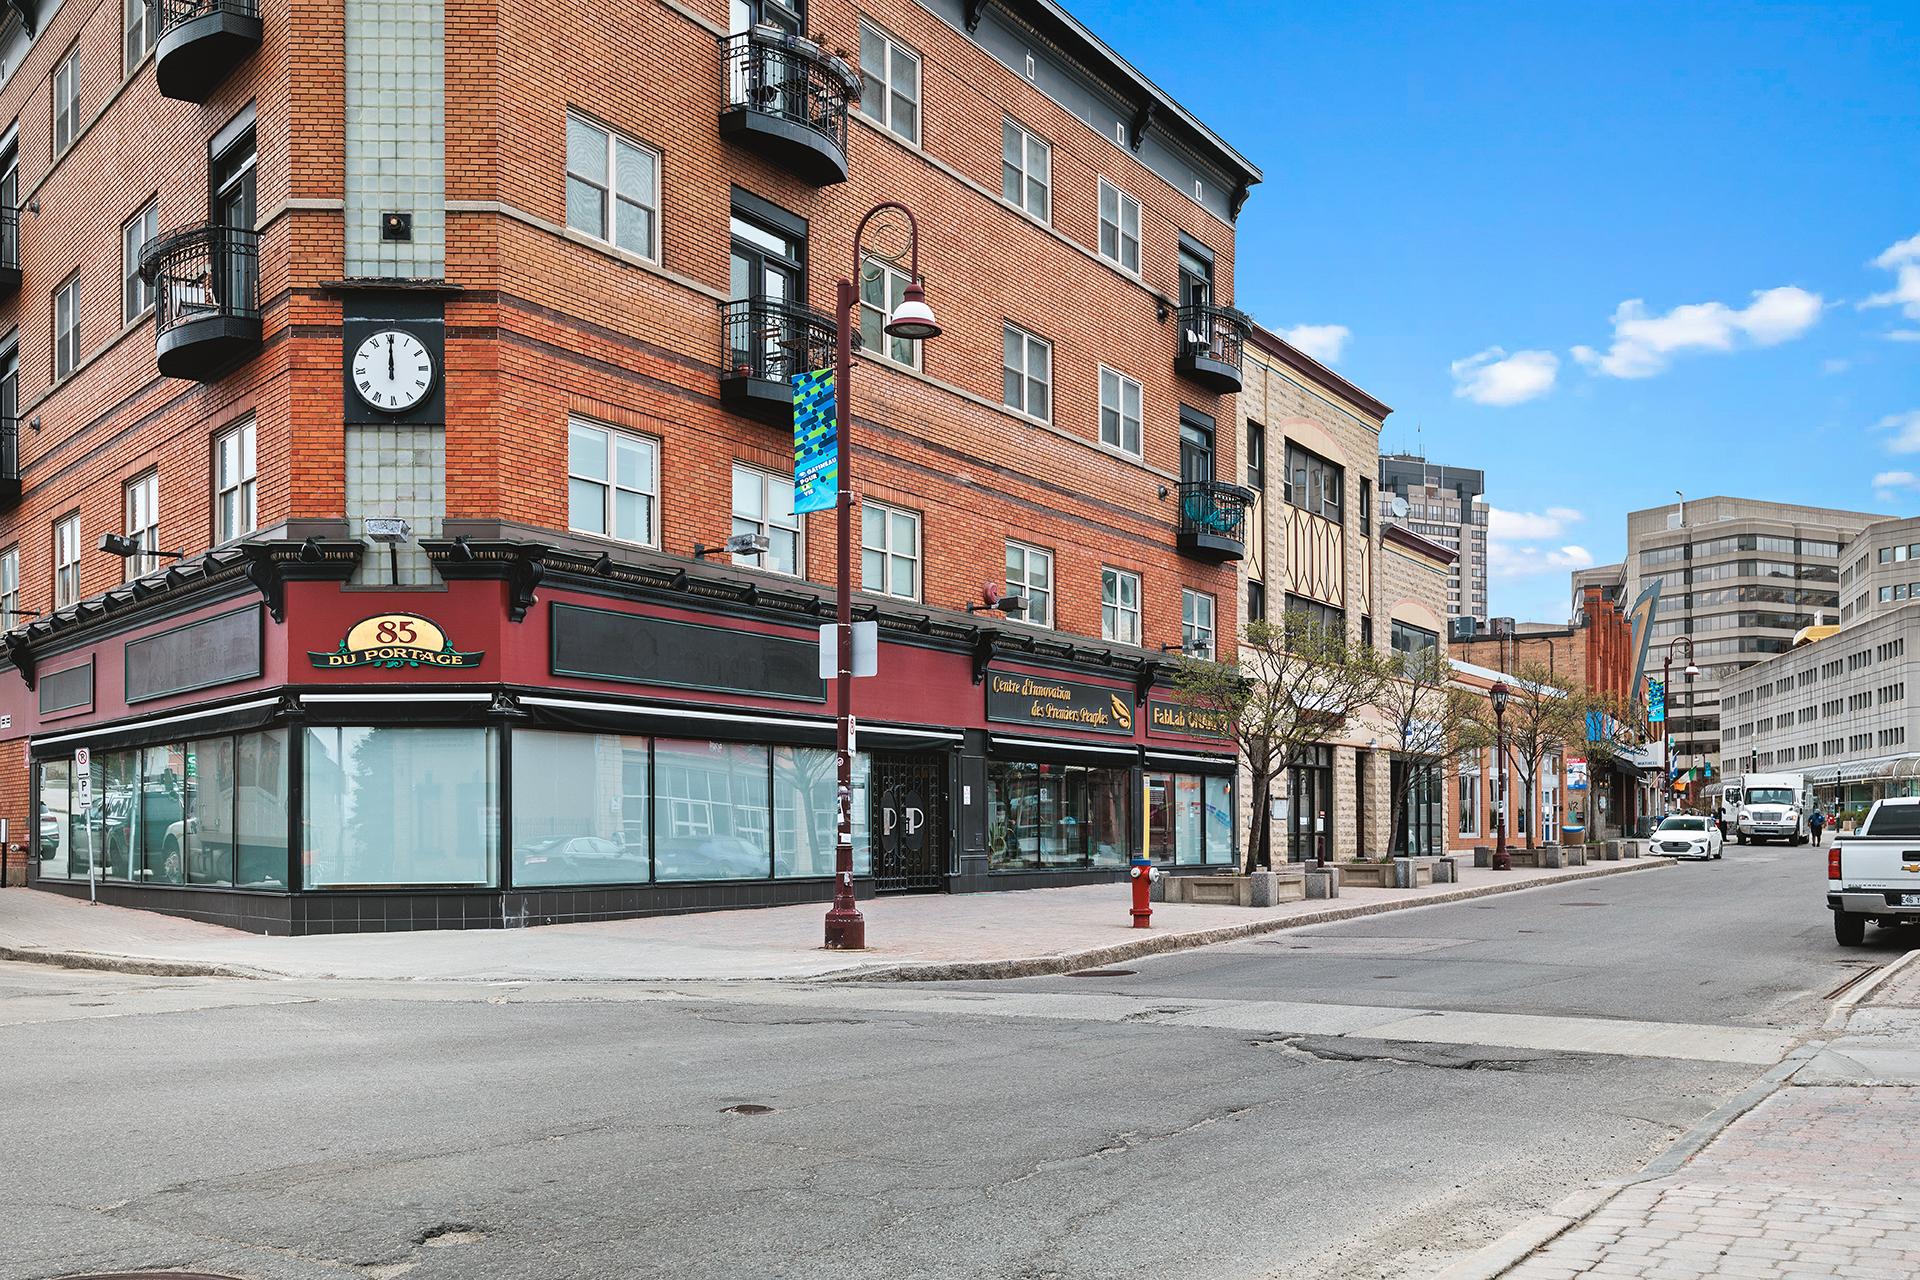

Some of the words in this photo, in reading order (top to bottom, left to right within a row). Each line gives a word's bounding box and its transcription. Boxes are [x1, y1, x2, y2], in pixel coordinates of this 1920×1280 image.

[358, 350, 369, 359] X
[806, 457, 837, 475] GATINEAU
[800, 473, 817, 485] POUR
[376, 620, 418, 644] 85
[328, 653, 357, 666] DU
[364, 648, 463, 665] PORTAGE
[992, 675, 1020, 694] Centre
[1021, 678, 1072, 701] d'Innovation
[1031, 700, 1045, 718] des
[1045, 703, 1080, 722] Premiers
[1153, 707, 1186, 727] FabLab
[81, 780, 87, 791] P
